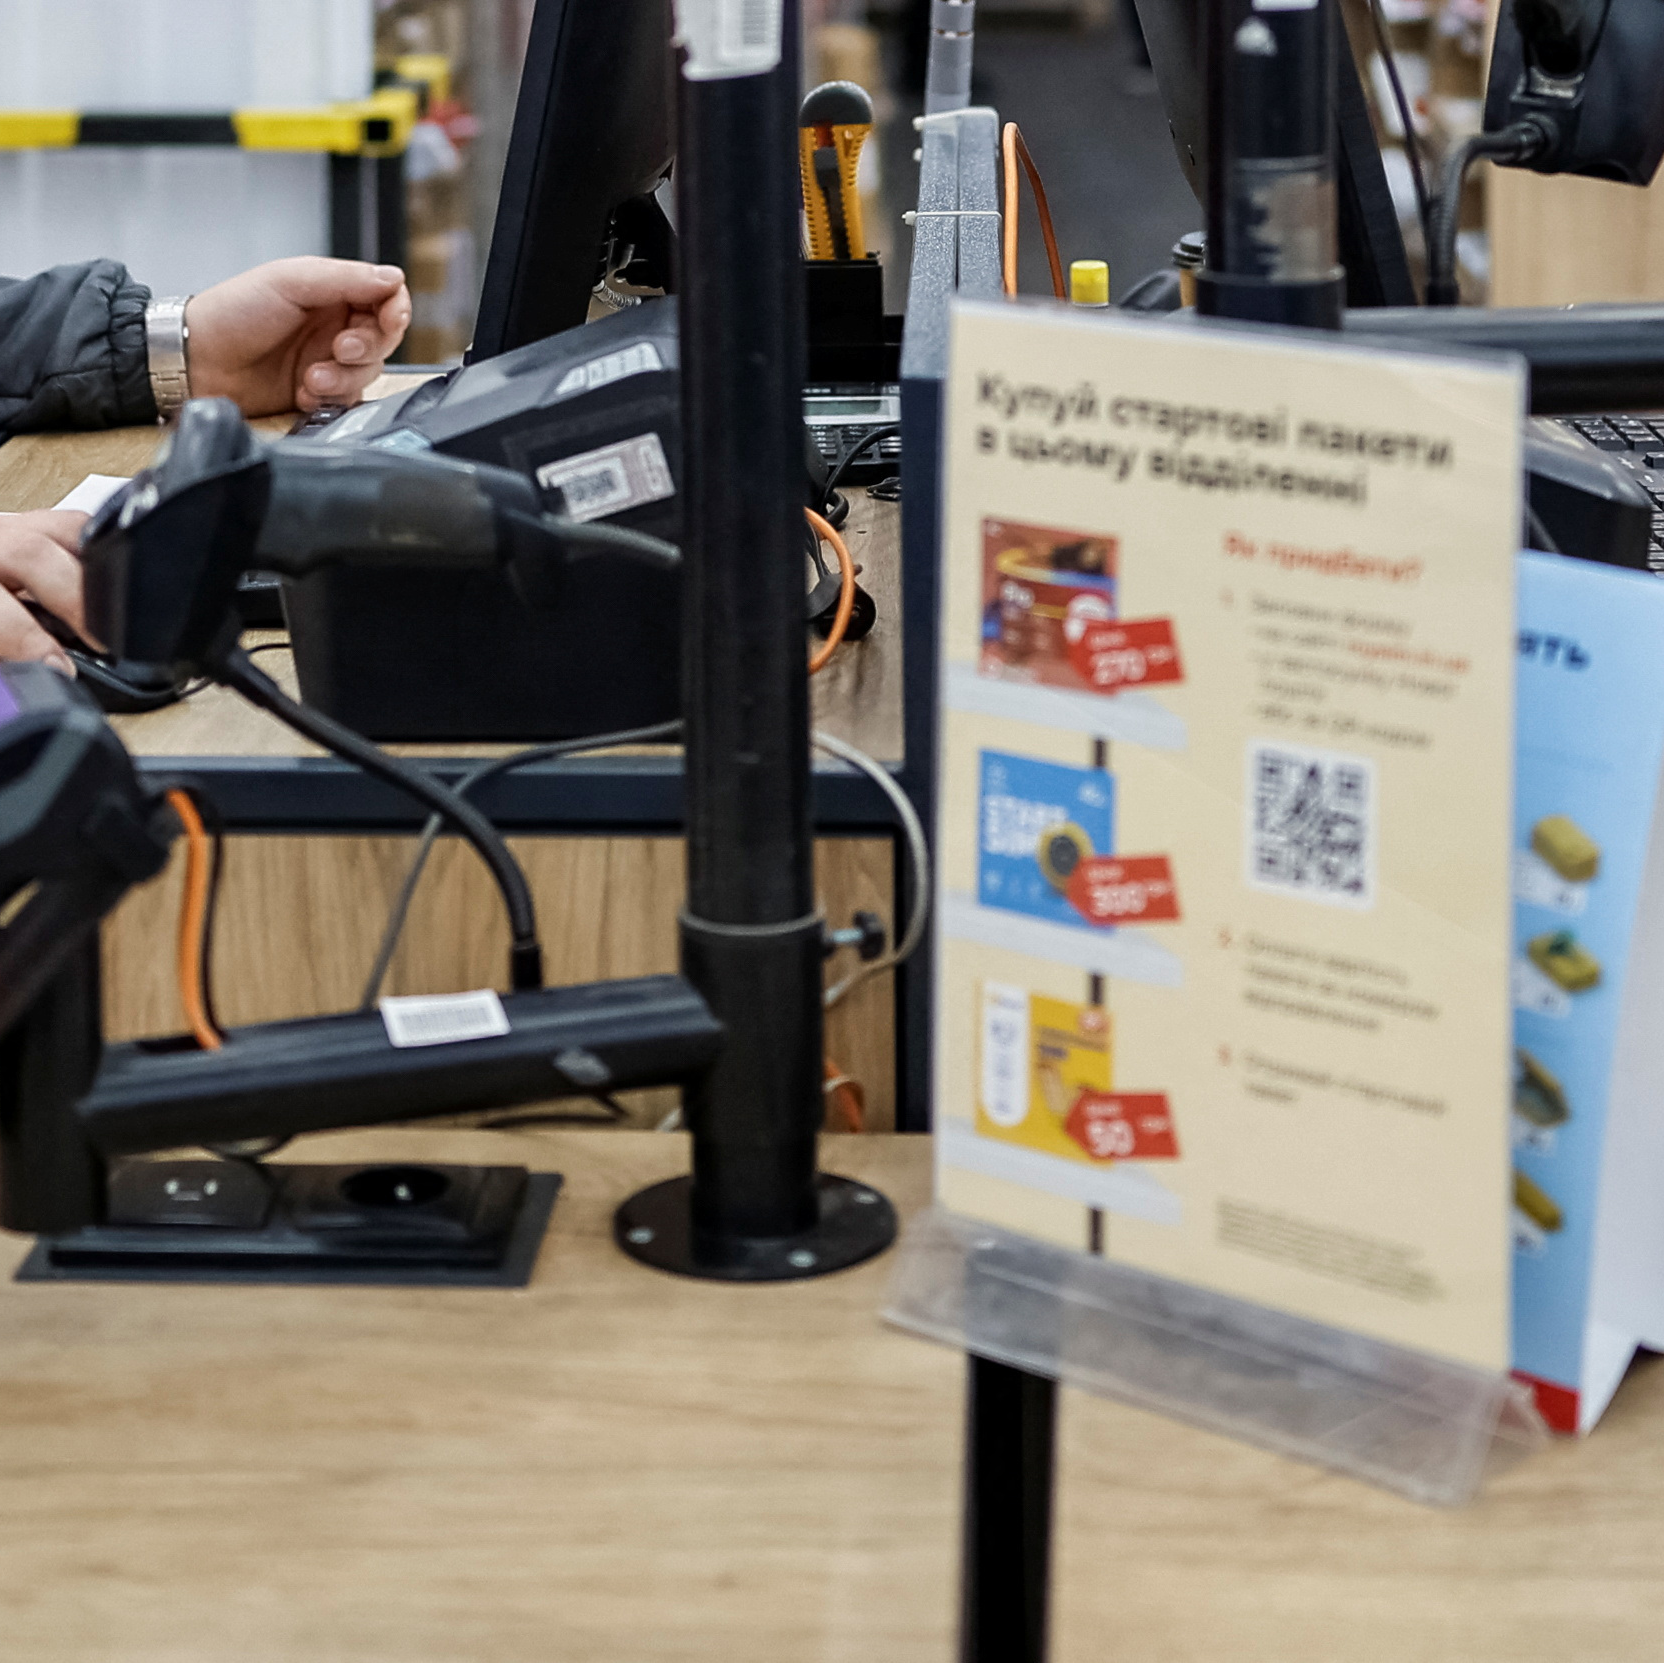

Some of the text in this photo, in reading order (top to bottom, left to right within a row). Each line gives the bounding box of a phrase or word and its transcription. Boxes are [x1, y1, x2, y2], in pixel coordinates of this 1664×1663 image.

[976, 372, 1453, 468] Купуй стартові пакети
[1010, 434, 1136, 483] цьому
[1149, 450, 1367, 506] відділенні
